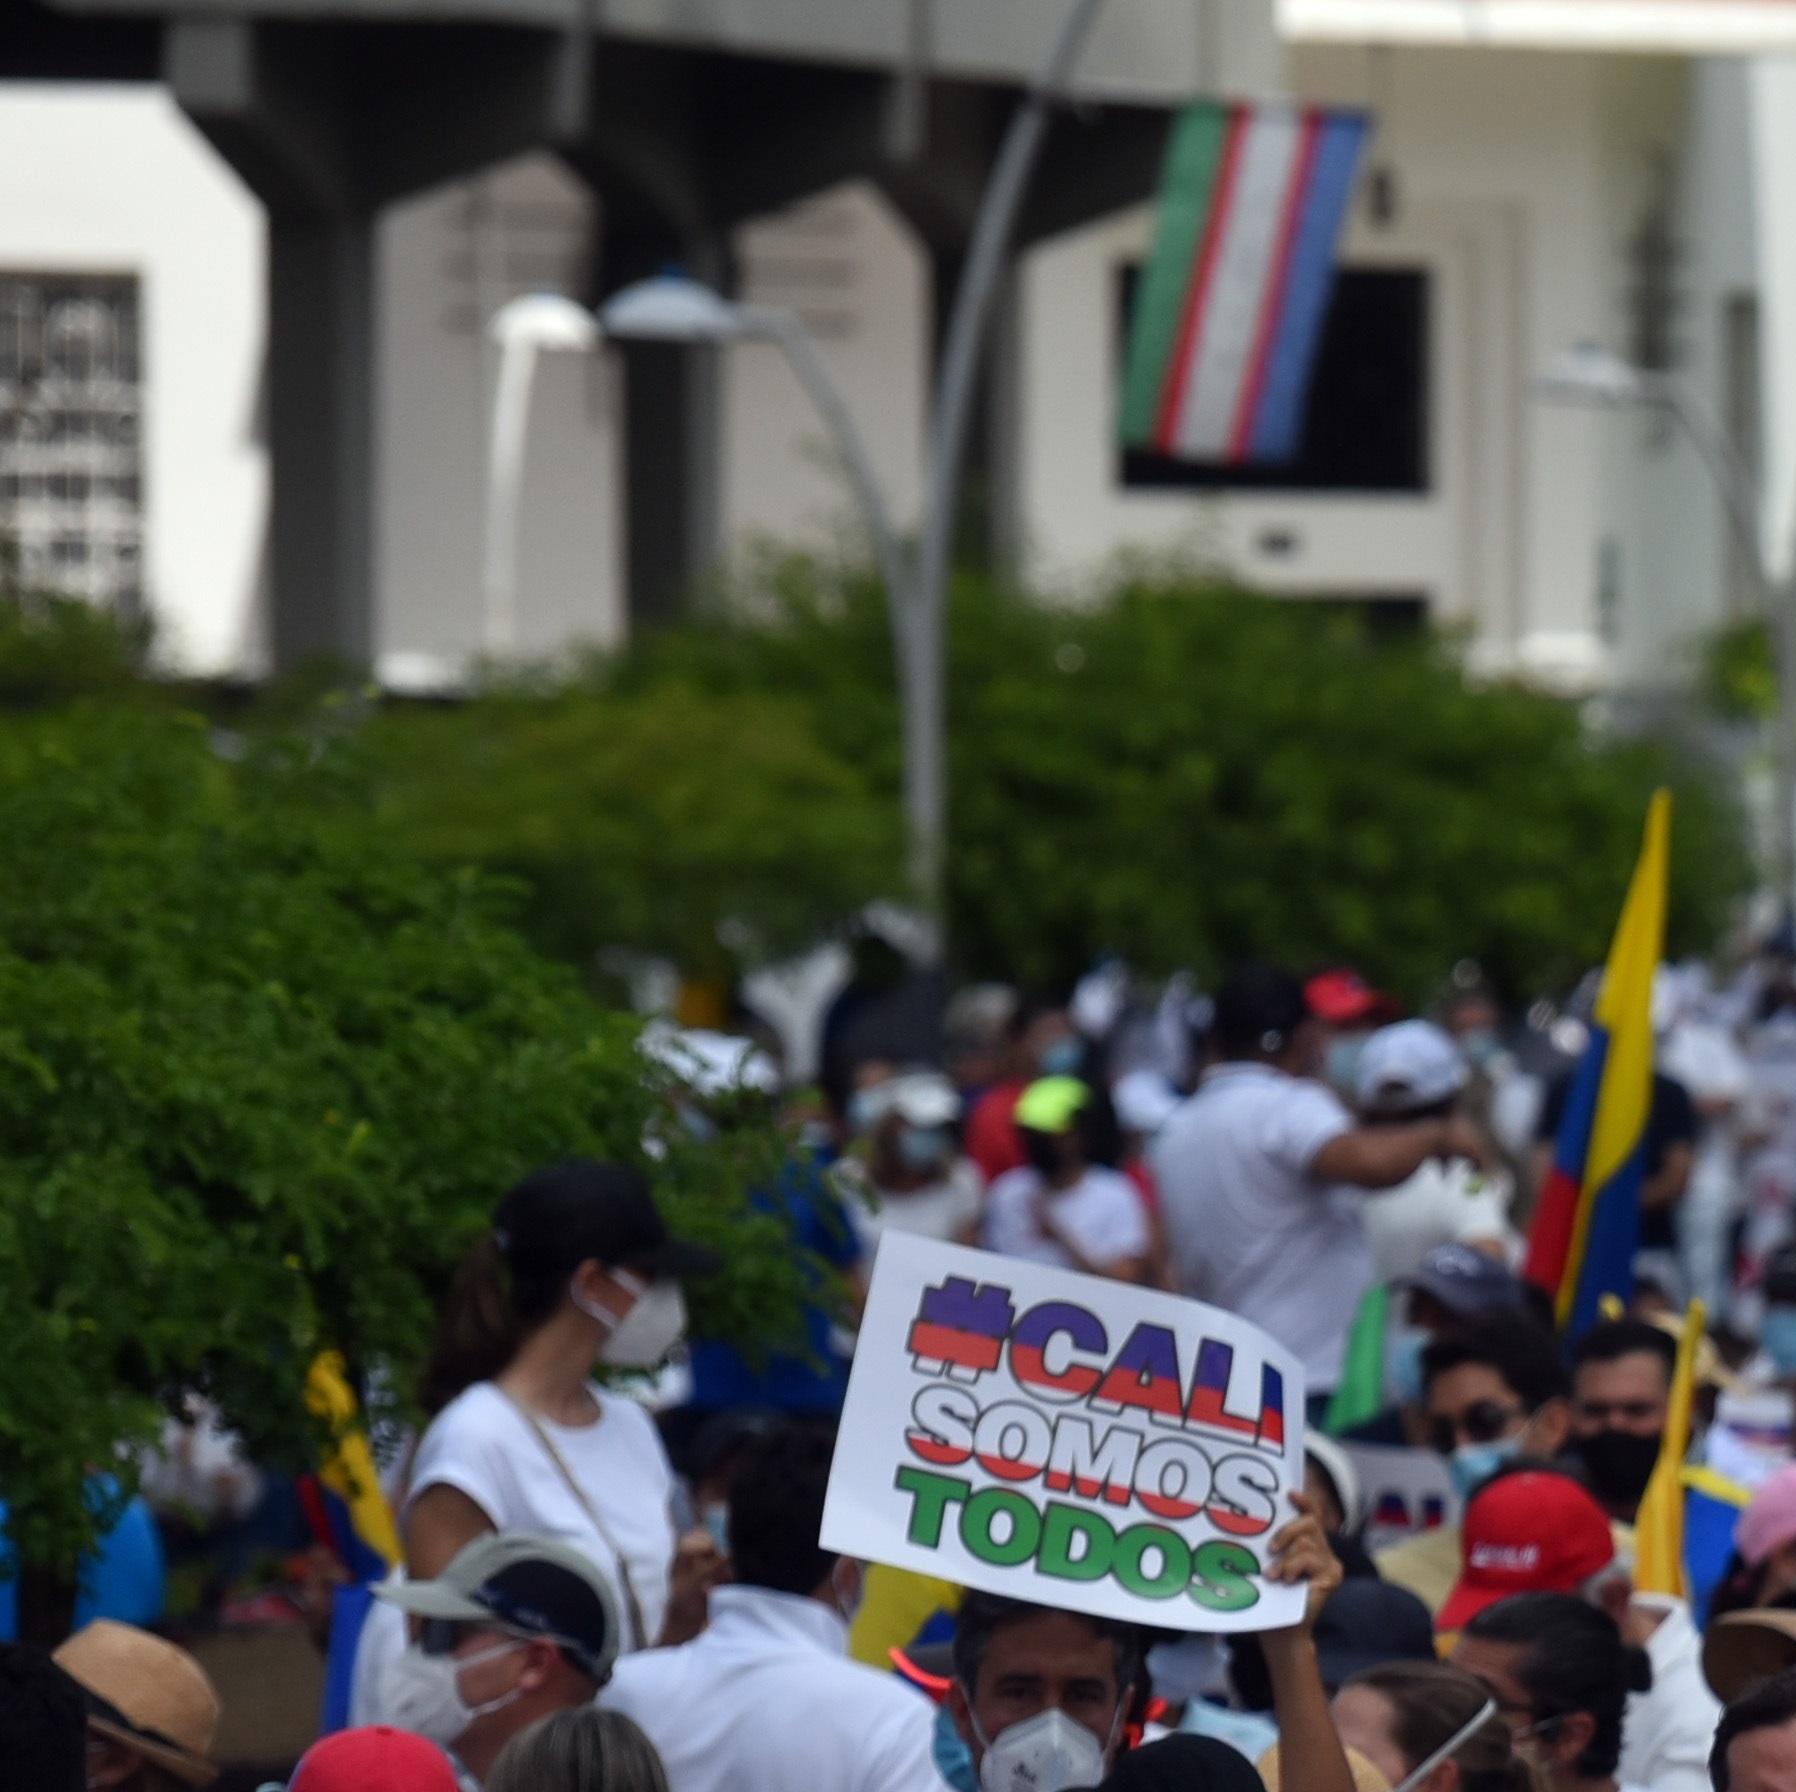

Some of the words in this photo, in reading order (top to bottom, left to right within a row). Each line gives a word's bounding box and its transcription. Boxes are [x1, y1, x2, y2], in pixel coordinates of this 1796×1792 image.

[906, 1273, 1286, 1457] #CALI
[904, 1382, 1280, 1537] SOMOS
[894, 1464, 1262, 1613] TODOS
